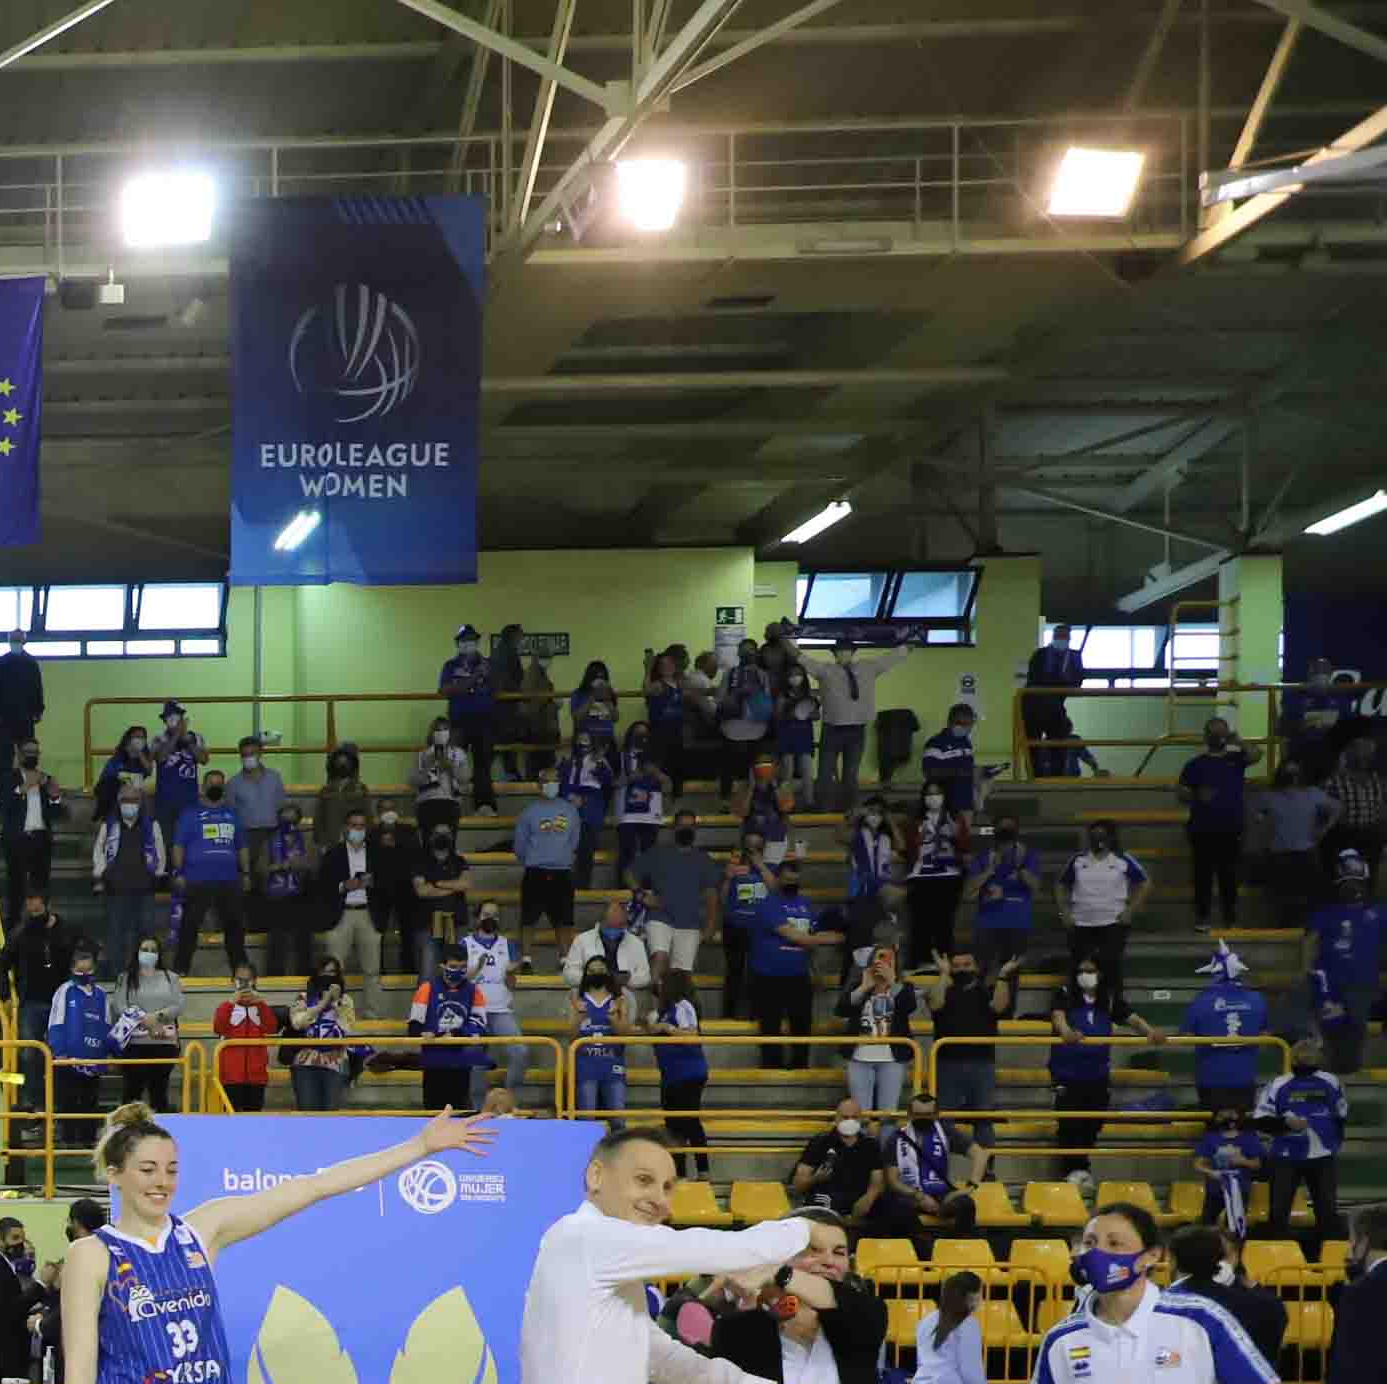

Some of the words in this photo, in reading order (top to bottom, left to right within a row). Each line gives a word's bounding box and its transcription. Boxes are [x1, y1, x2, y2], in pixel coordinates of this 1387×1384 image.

[259, 443, 450, 468] EUROLEAGUE
[299, 472, 408, 498] WOMEN
[460, 1183, 504, 1193] MUJER
[165, 1320, 199, 1358] 33
[167, 1359, 221, 1384] YRSA
